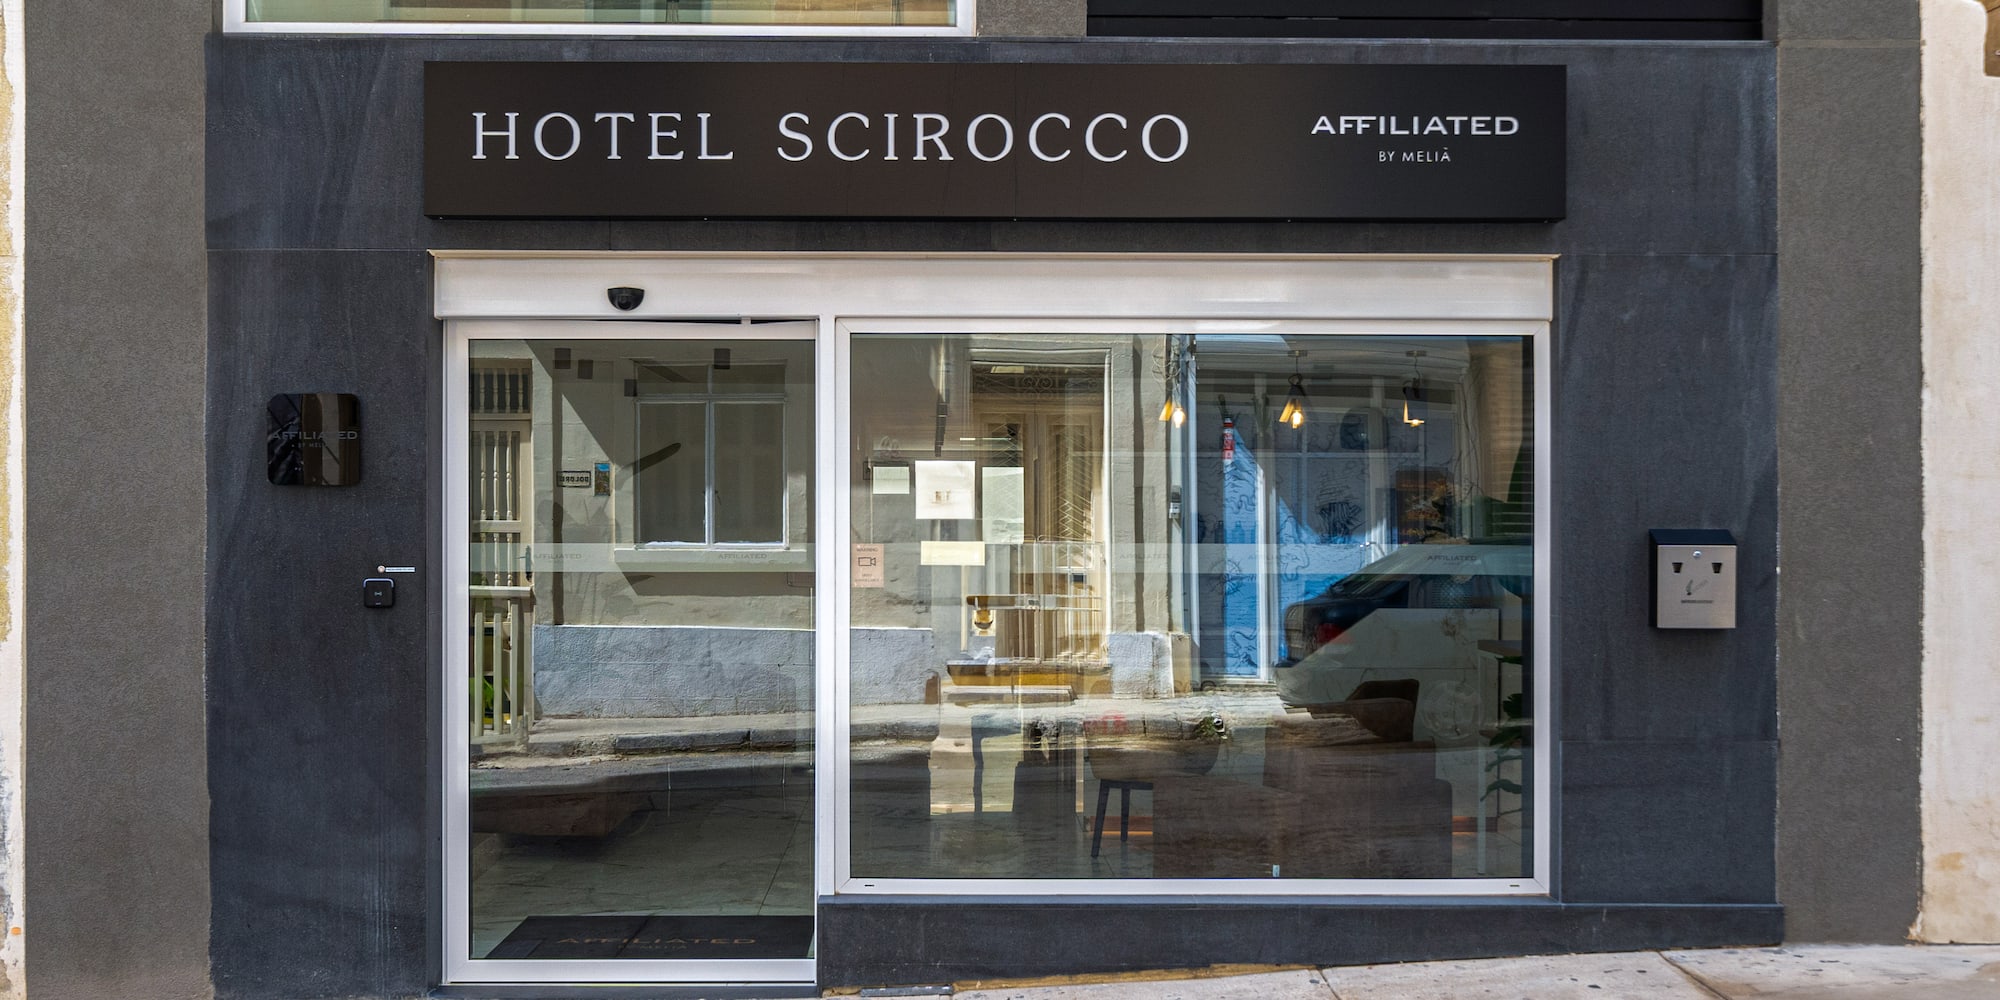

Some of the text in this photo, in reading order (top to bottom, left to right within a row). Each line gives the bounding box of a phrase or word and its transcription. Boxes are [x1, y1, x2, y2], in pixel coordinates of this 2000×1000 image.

[1310, 115, 1519, 135] AFFILIATED
[472, 112, 1190, 163] HOTEL SCIROCCO
[1378, 151, 1395, 162] BY
[272, 431, 358, 440] AFFILIAED
